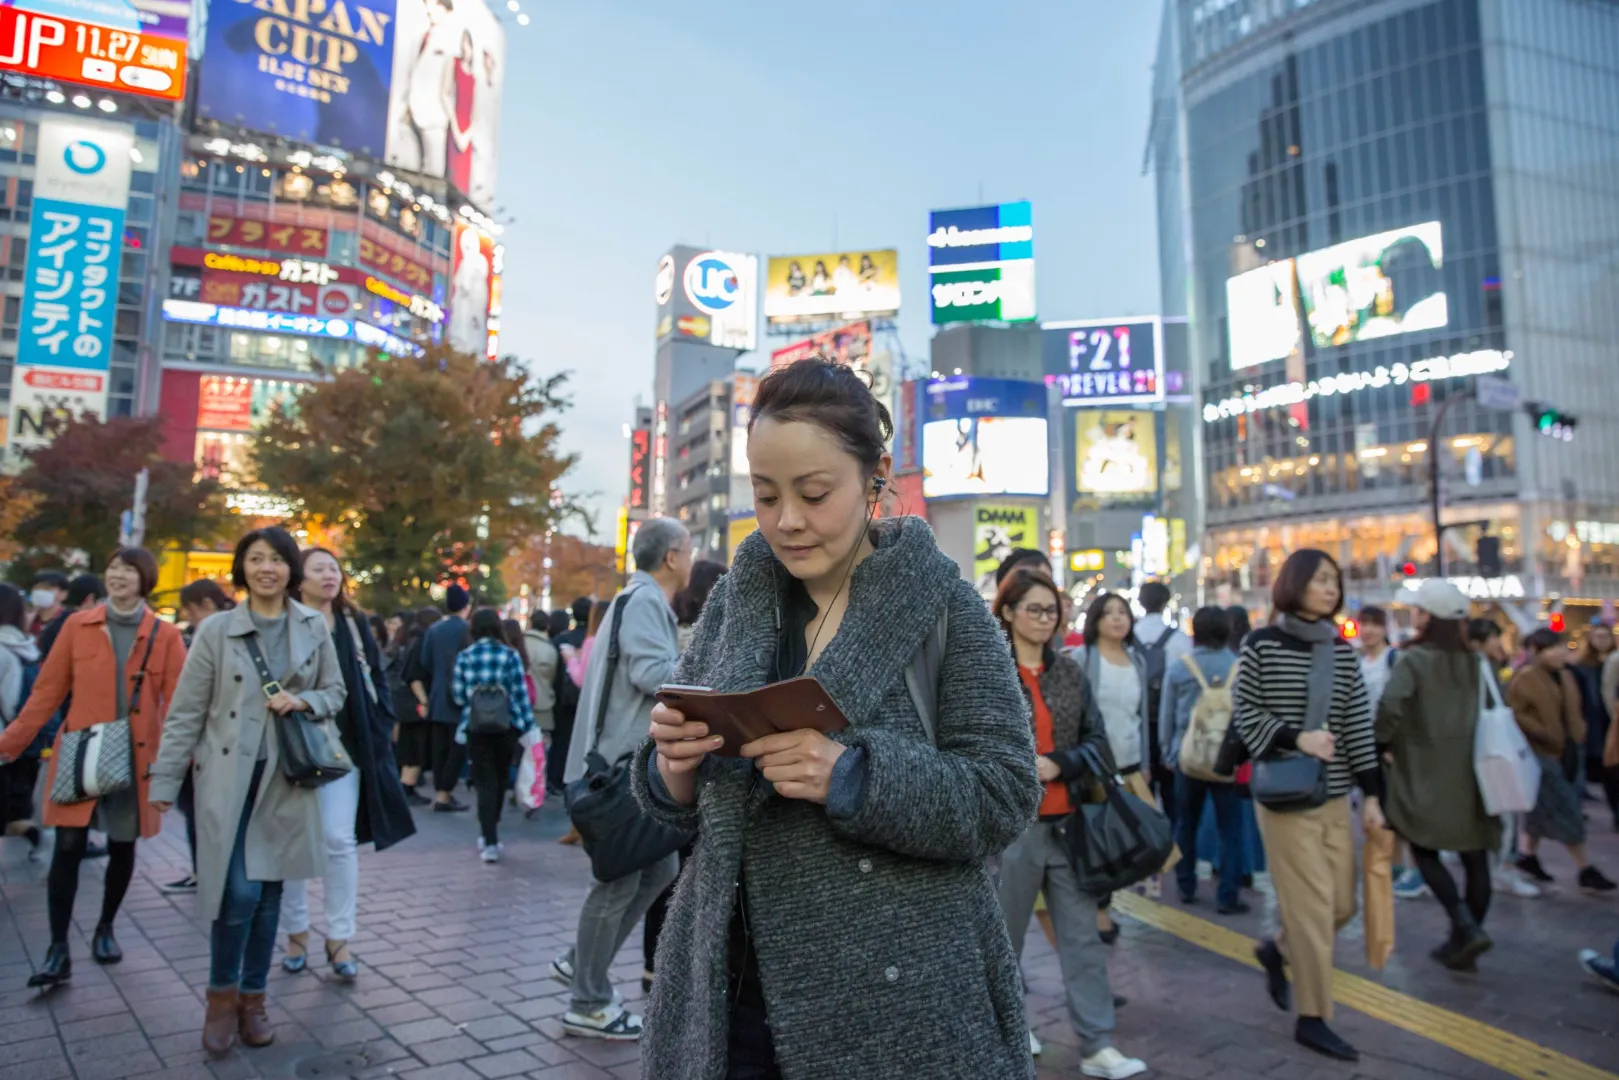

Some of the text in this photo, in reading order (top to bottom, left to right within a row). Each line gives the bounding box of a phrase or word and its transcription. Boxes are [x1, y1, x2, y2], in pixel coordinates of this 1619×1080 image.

[75, 25, 140, 62] 11.27
[254, 16, 358, 74] CUP
[208, 217, 324, 248] プライス
[32, 211, 80, 355] アイシティ
[72, 217, 113, 358] コンタクトの
[279, 258, 339, 285] ガスト
[240, 281, 313, 312] ガスト
[1069, 326, 1131, 371] F21
[975, 524, 1012, 546] FX
